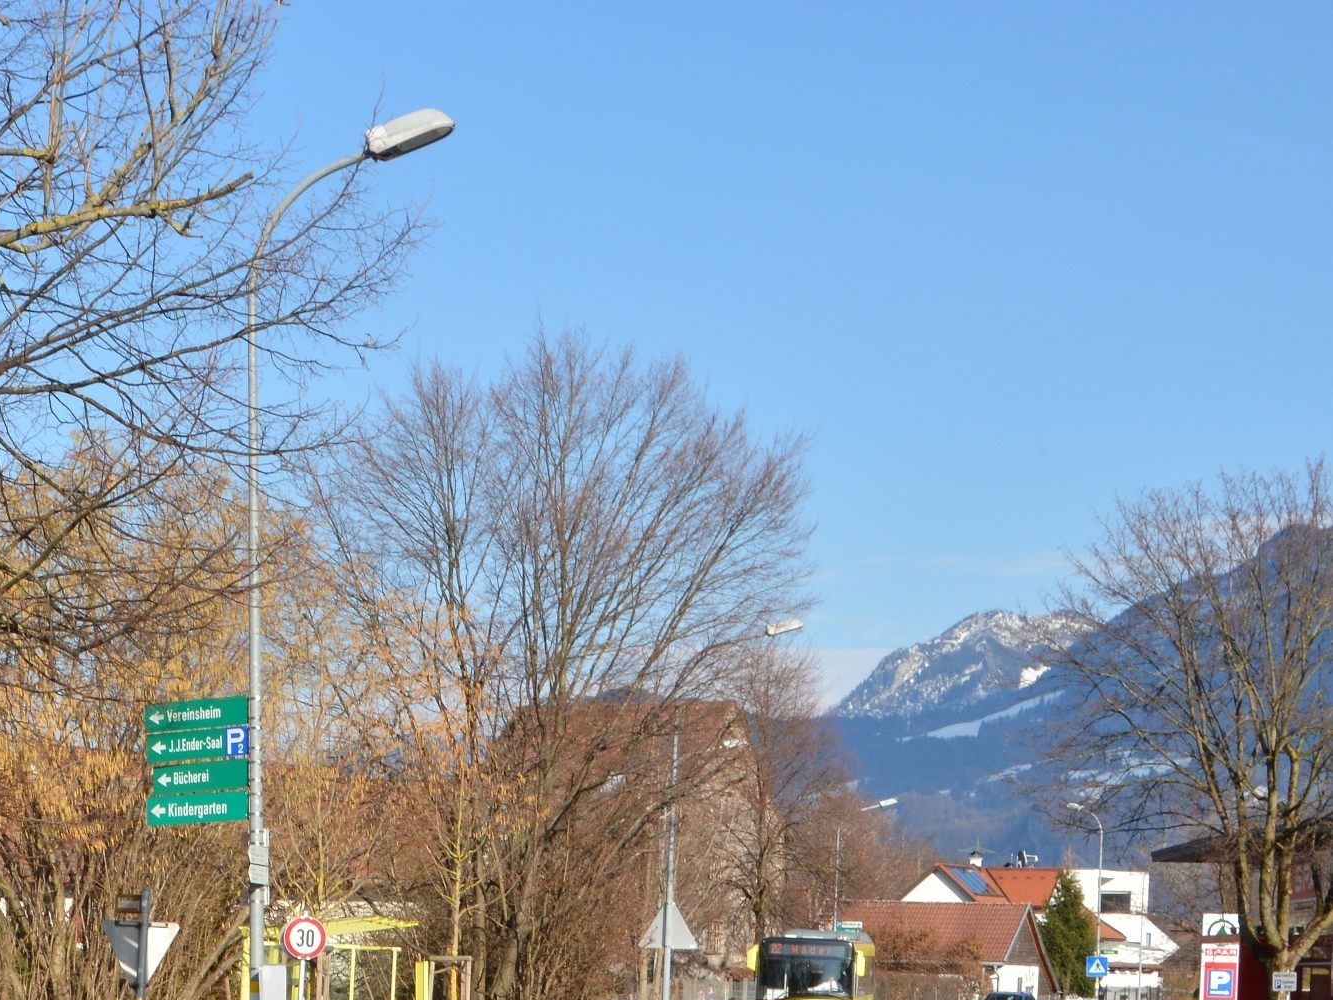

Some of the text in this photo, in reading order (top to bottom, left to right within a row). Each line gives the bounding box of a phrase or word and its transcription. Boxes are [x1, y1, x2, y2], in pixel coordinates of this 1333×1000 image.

[167, 706, 221, 722] Vereinsheim
[173, 769, 209, 785] Bücherei
[168, 802, 227, 819] Kindergarten
[296, 929, 315, 948] 30
